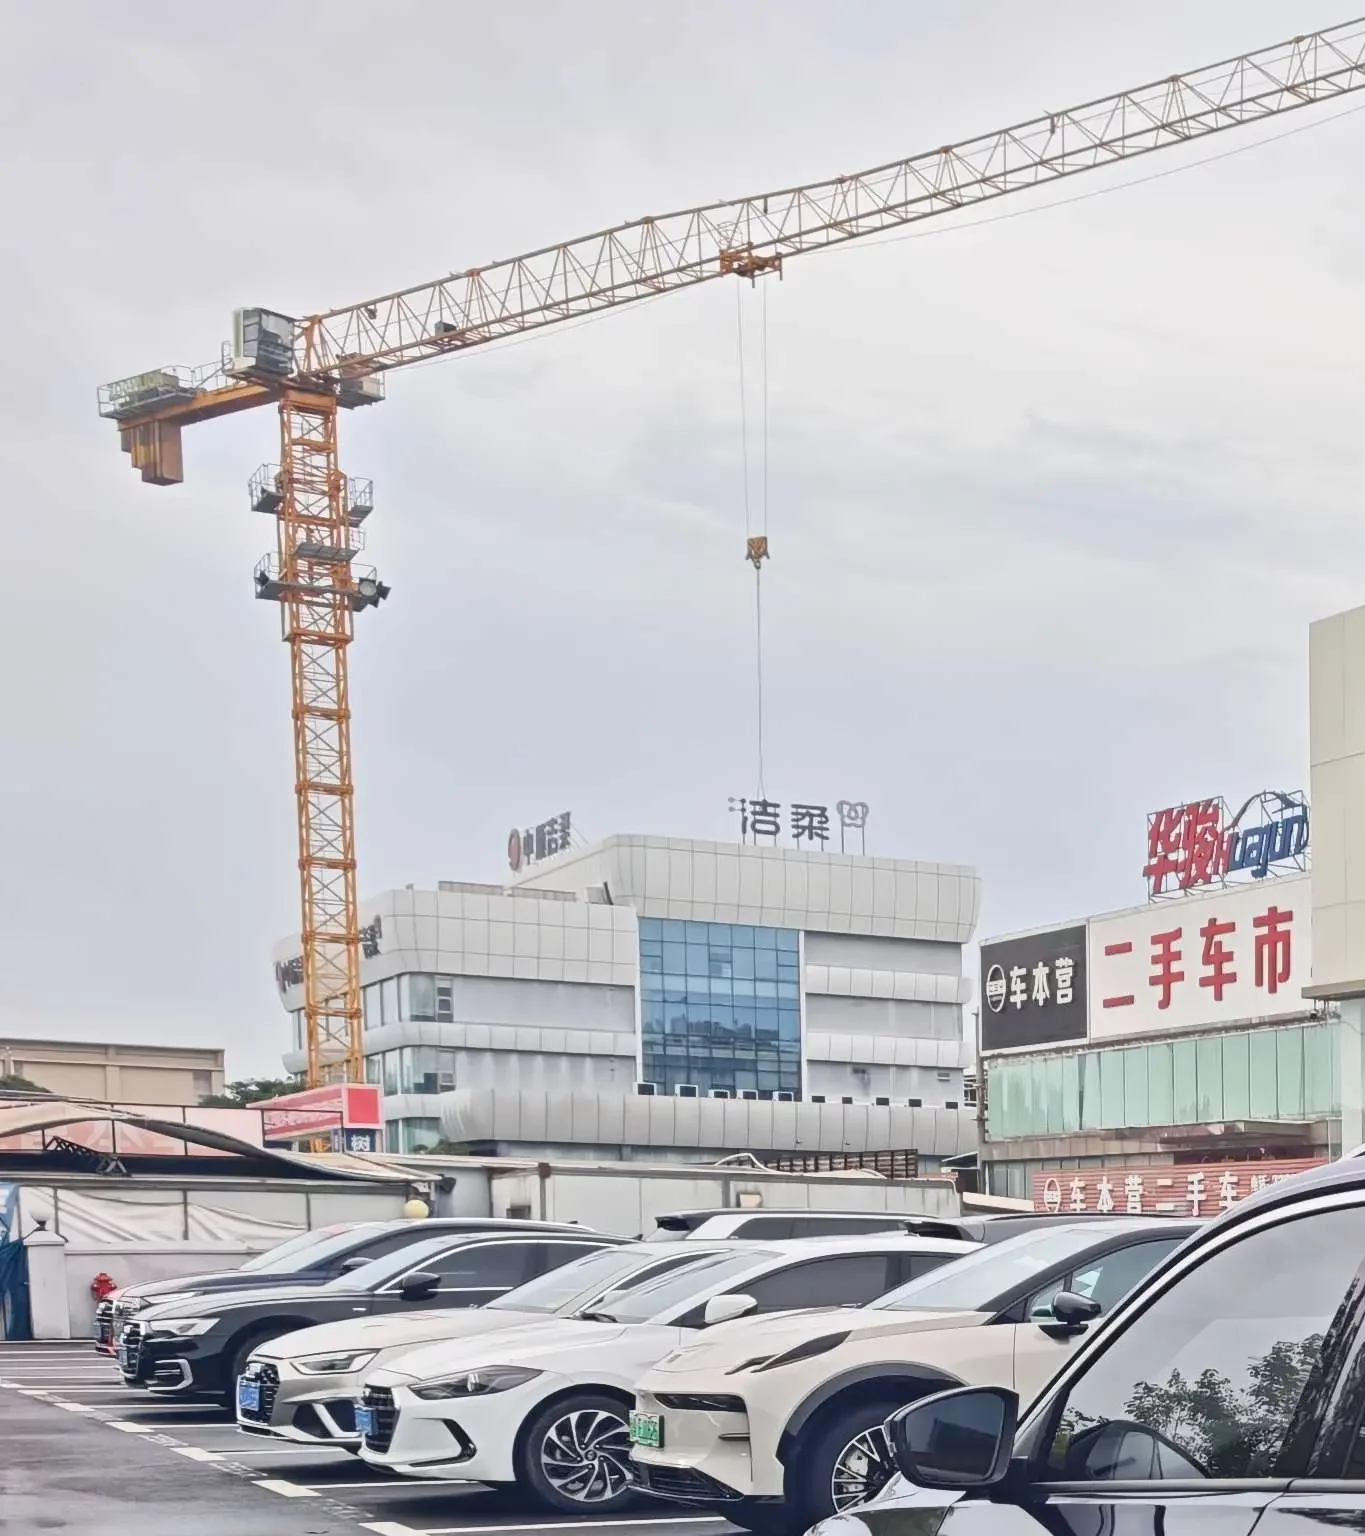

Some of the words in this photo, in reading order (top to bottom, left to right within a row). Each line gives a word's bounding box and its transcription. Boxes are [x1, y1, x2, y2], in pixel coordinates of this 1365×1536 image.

[740, 798, 830, 841] 洁柔
[1009, 957, 1077, 1011] 车本营
[1102, 905, 1294, 1010] 二手车市
